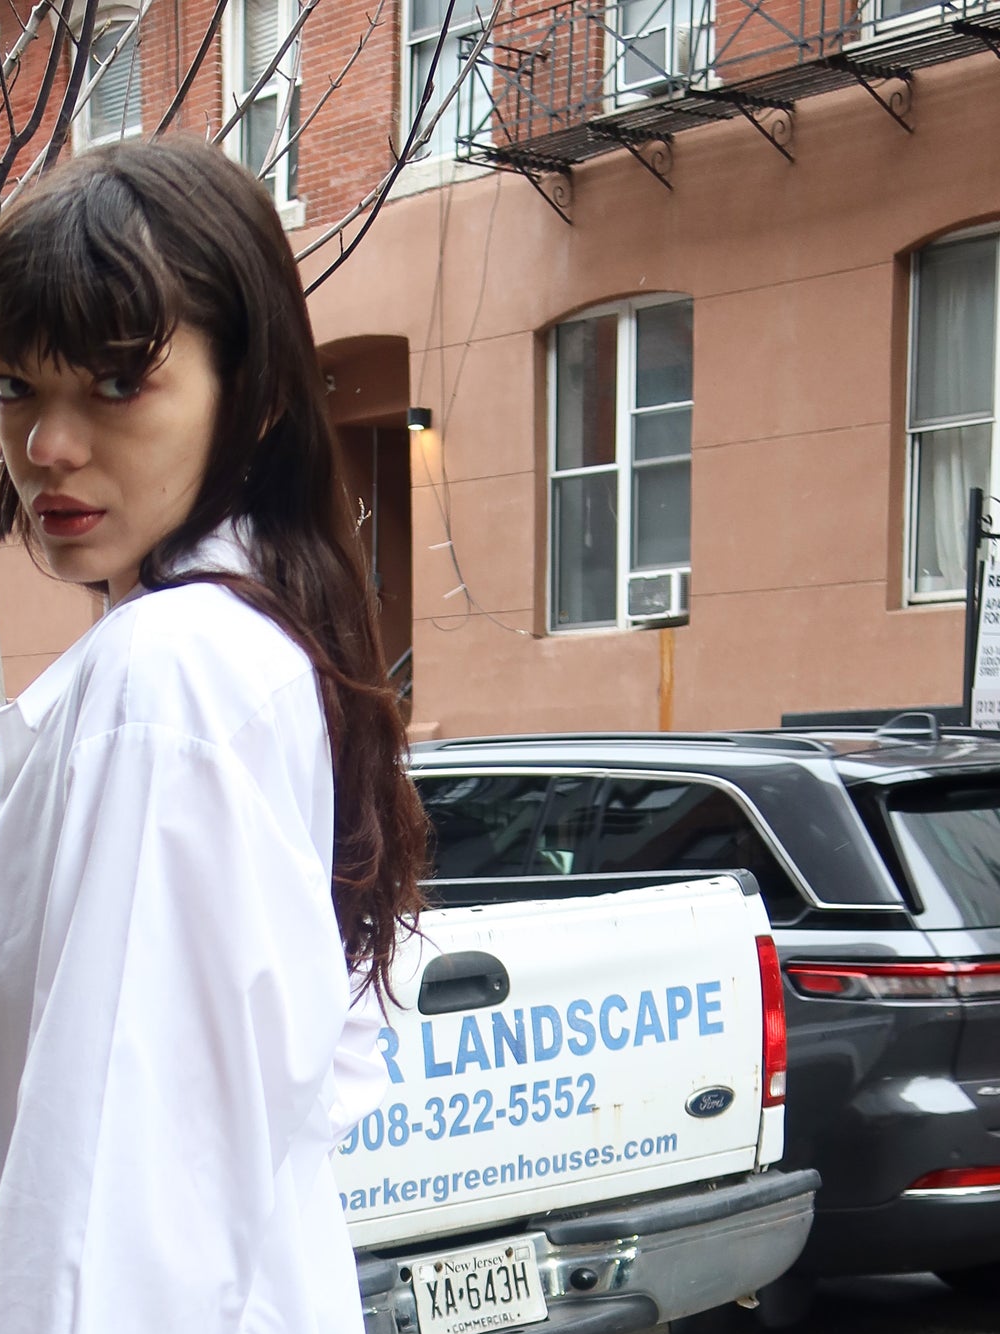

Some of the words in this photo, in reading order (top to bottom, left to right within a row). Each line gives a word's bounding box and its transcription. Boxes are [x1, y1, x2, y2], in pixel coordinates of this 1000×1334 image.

[421, 980, 725, 1080] LANDSCAPE
[444, 1261, 471, 1276] New
[472, 1255, 504, 1273] Jersey
[453, 1312, 516, 1334] COMMERCIAL
